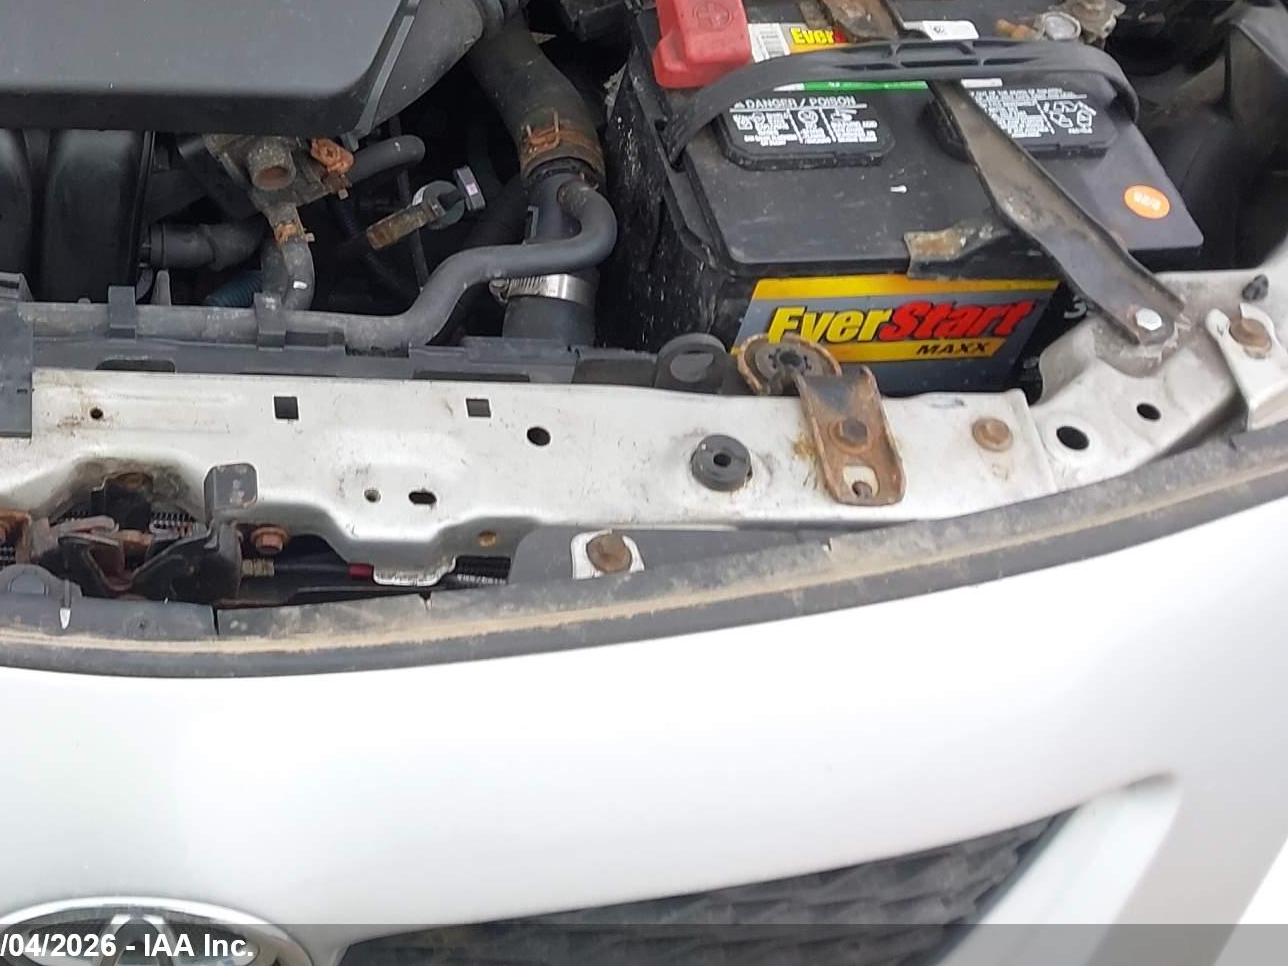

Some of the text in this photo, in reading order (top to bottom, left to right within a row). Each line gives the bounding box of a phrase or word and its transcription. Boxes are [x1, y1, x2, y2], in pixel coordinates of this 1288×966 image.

[745, 97, 797, 109] DANGER
[766, 299, 1036, 344] EverStart
[915, 341, 992, 356] MAXX
